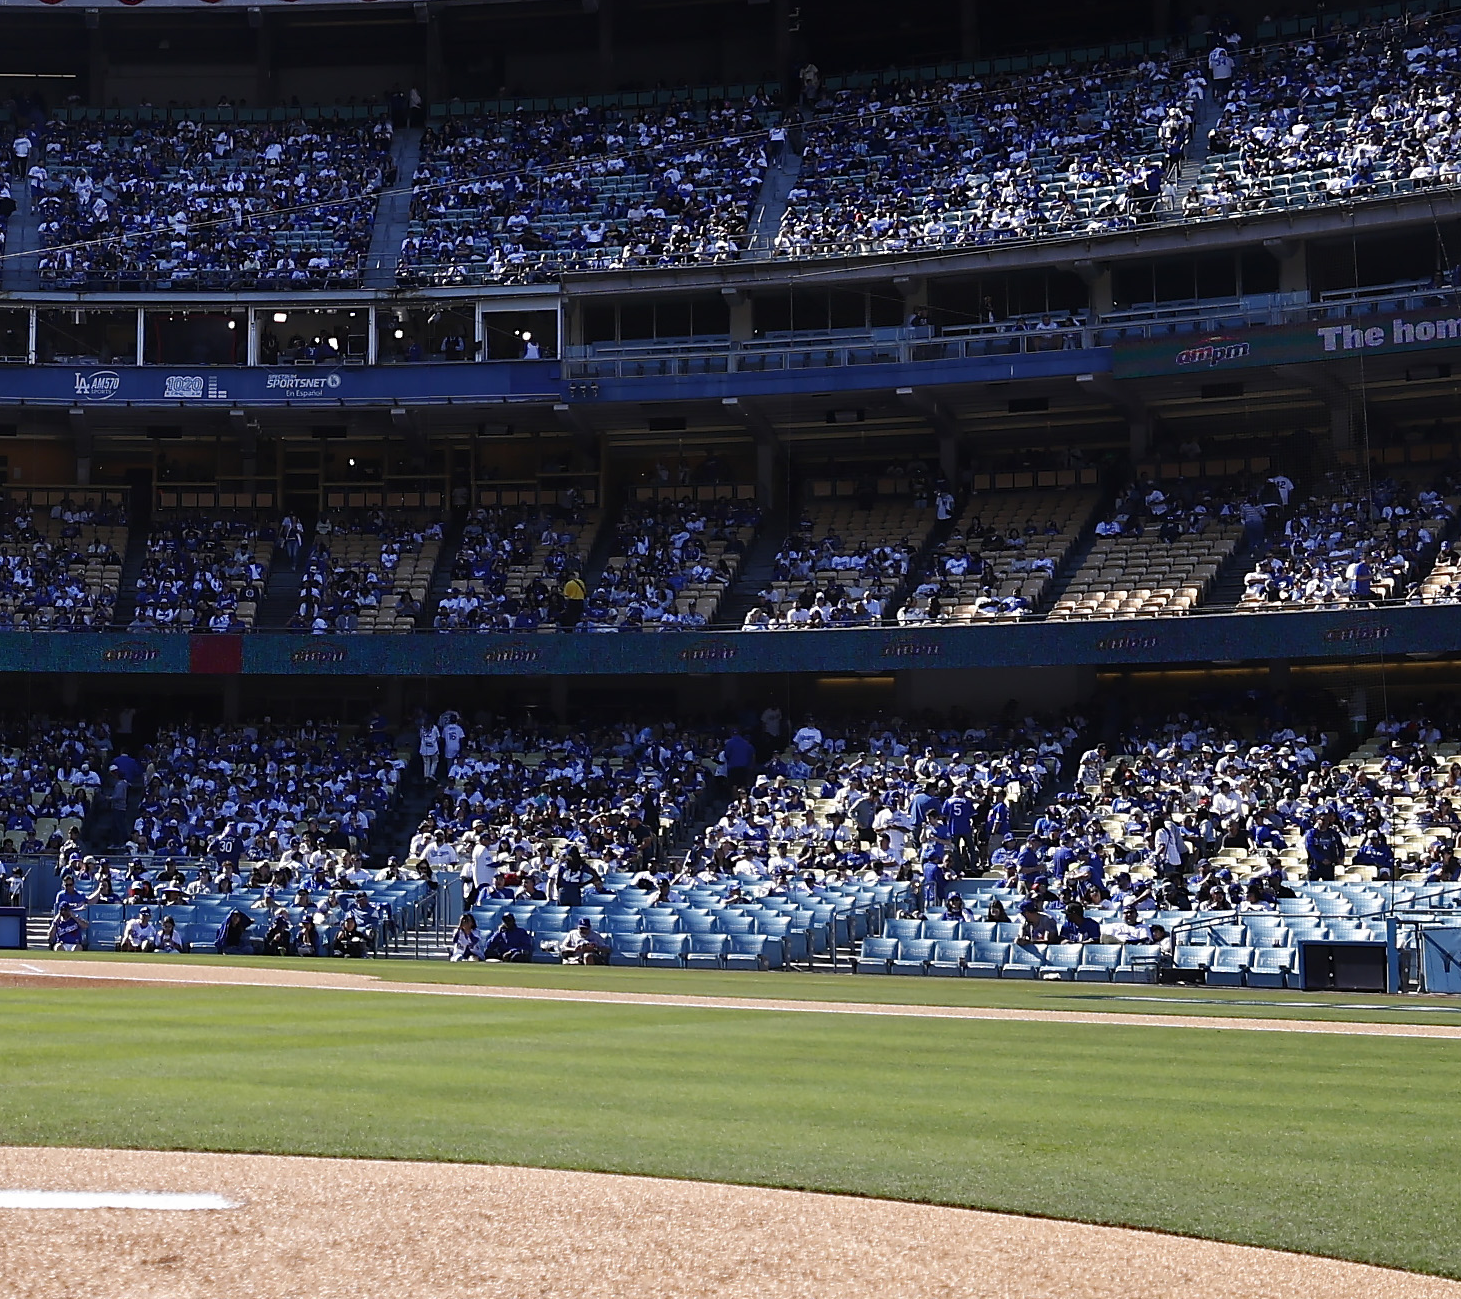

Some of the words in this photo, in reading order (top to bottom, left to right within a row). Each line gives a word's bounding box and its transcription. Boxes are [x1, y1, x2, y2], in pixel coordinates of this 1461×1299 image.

[1316, 326, 1385, 352] The
[1175, 342, 1251, 368] ampm
[74, 372, 90, 394] LA
[90, 377, 120, 390] AM570
[166, 376, 204, 392] 1020
[266, 379, 328, 389] SPORTSNET
[286, 389, 295, 397] En
[296, 389, 323, 398] Español
[952, 802, 962, 816] 5
[219, 840, 234, 853] 30
